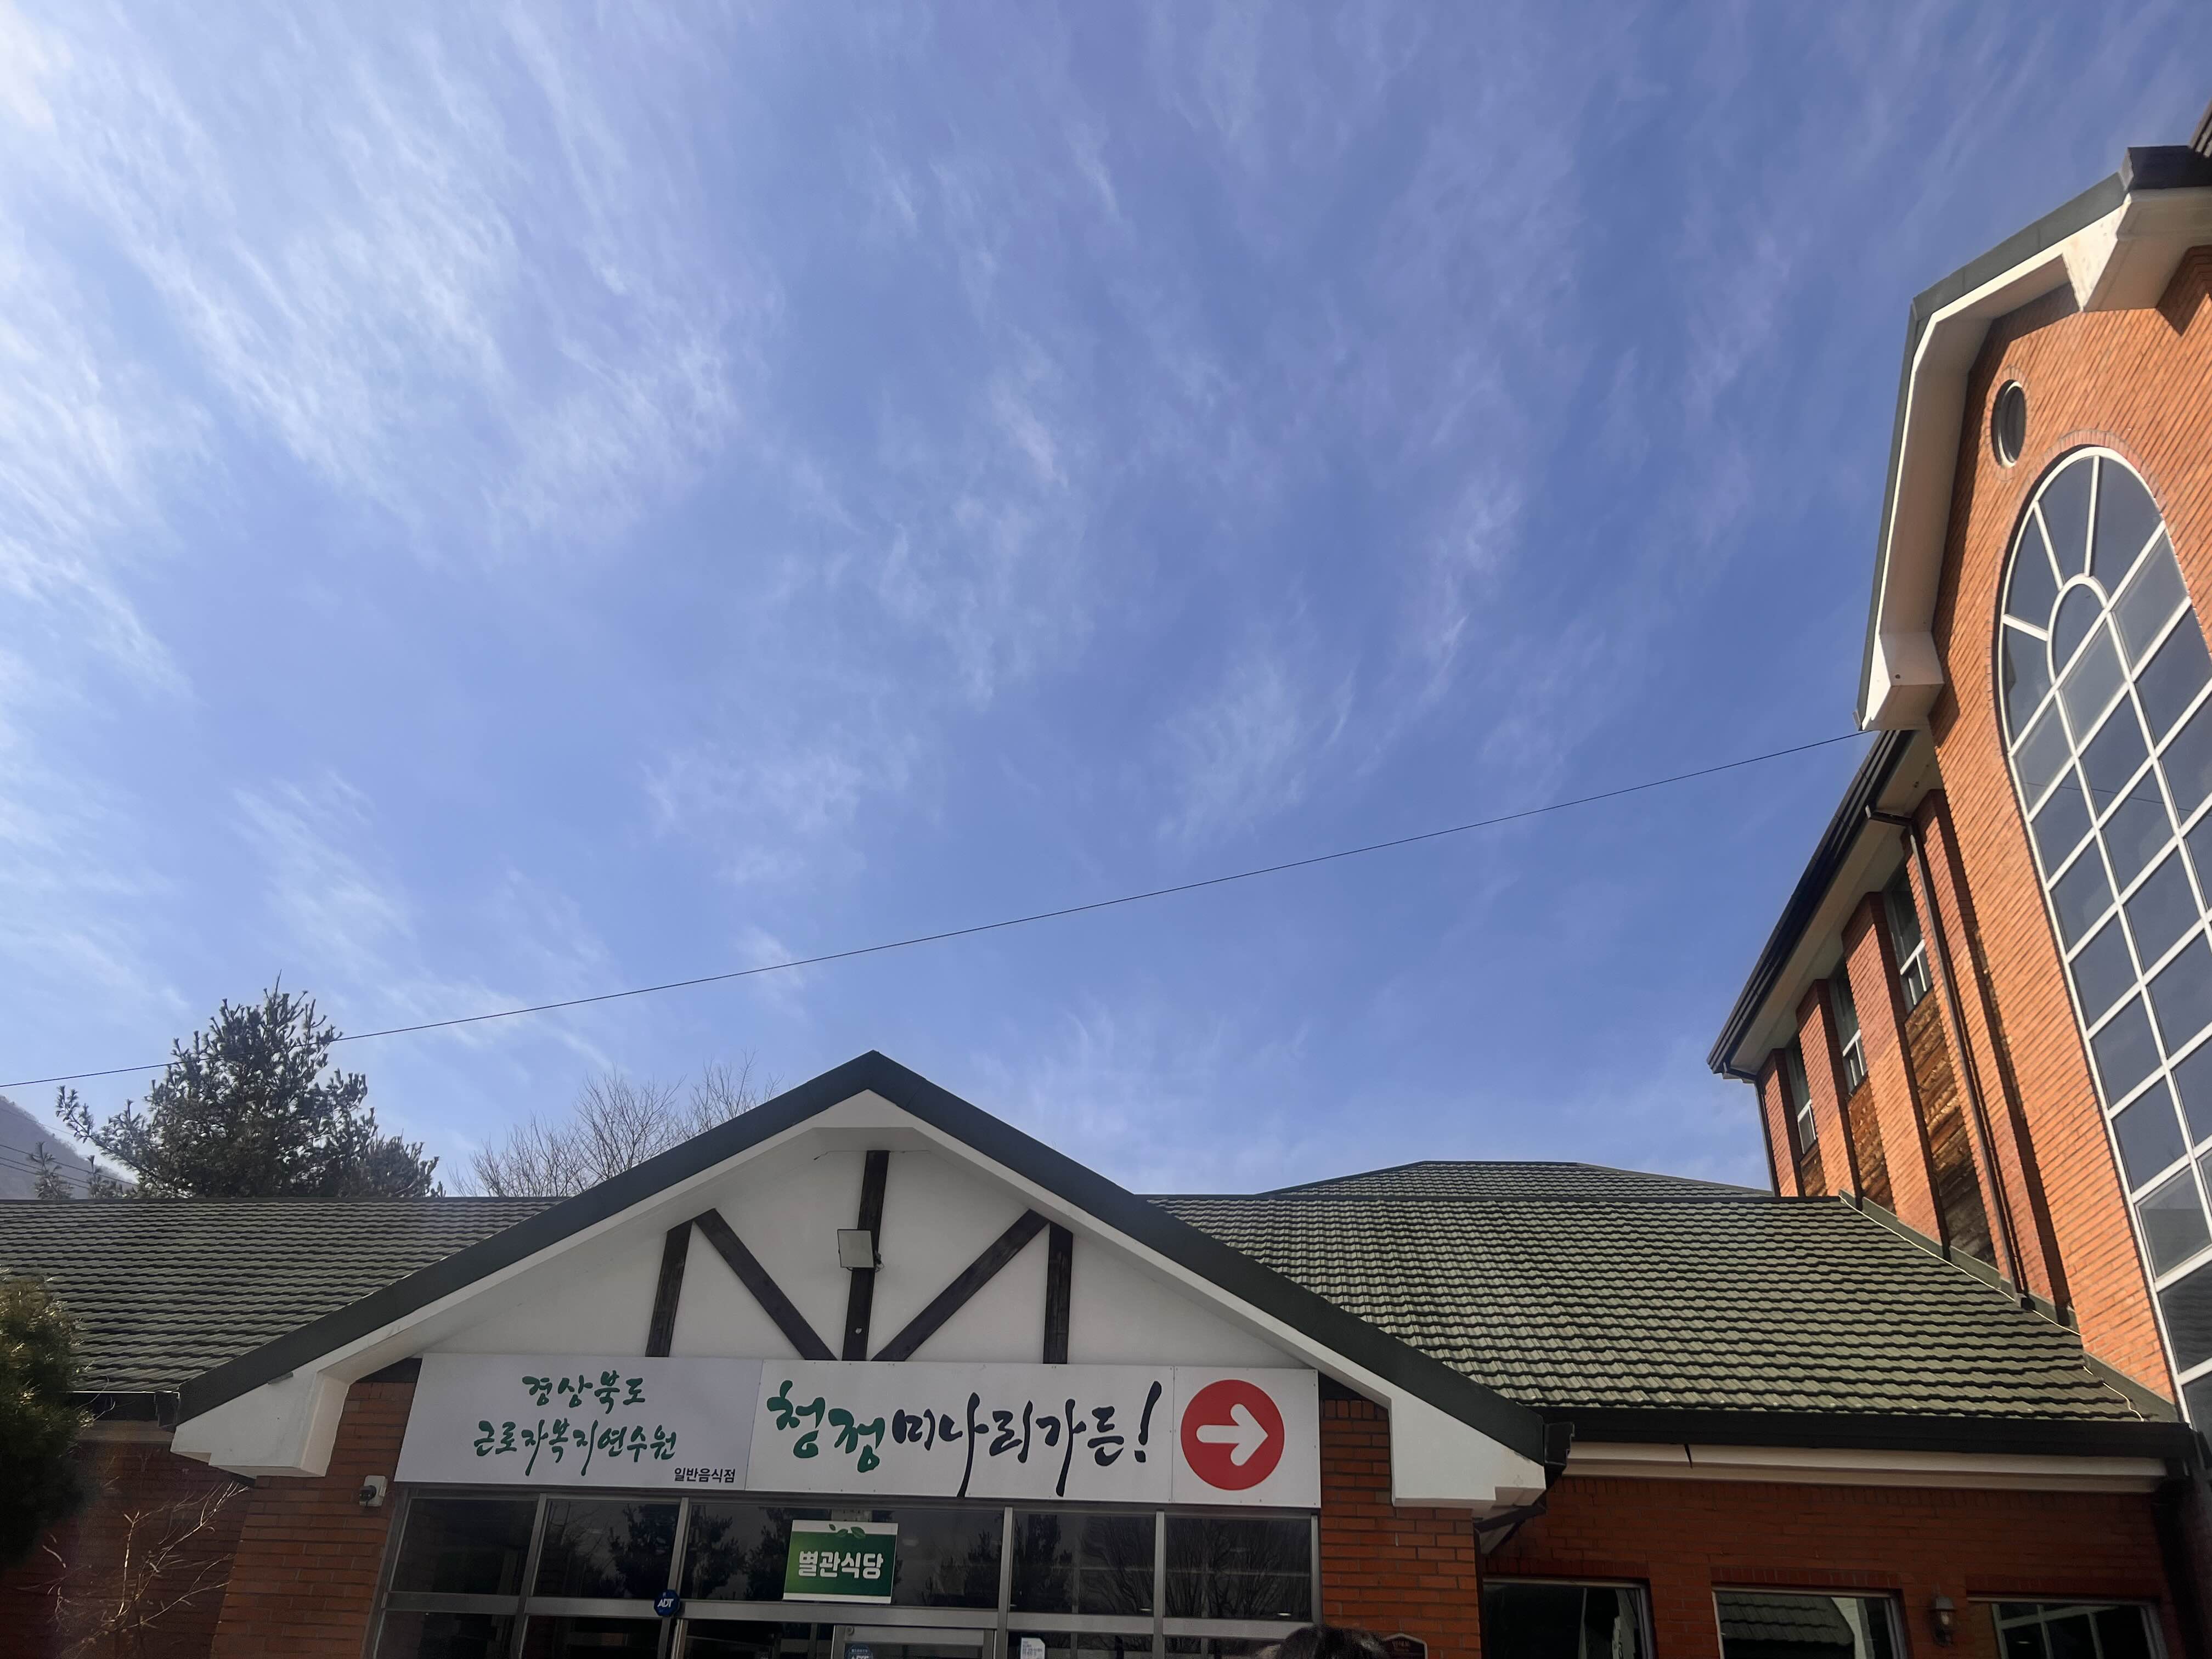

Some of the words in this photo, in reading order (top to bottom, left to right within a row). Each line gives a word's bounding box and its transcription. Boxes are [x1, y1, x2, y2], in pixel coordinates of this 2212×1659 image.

[522, 1369, 646, 1414] 경상북도
[473, 1417, 676, 1476] 근로자복지연수원
[674, 1467, 736, 1483] 일반음식점
[798, 1550, 884, 1579] 별관식당
[657, 1598, 674, 1607] ADT
